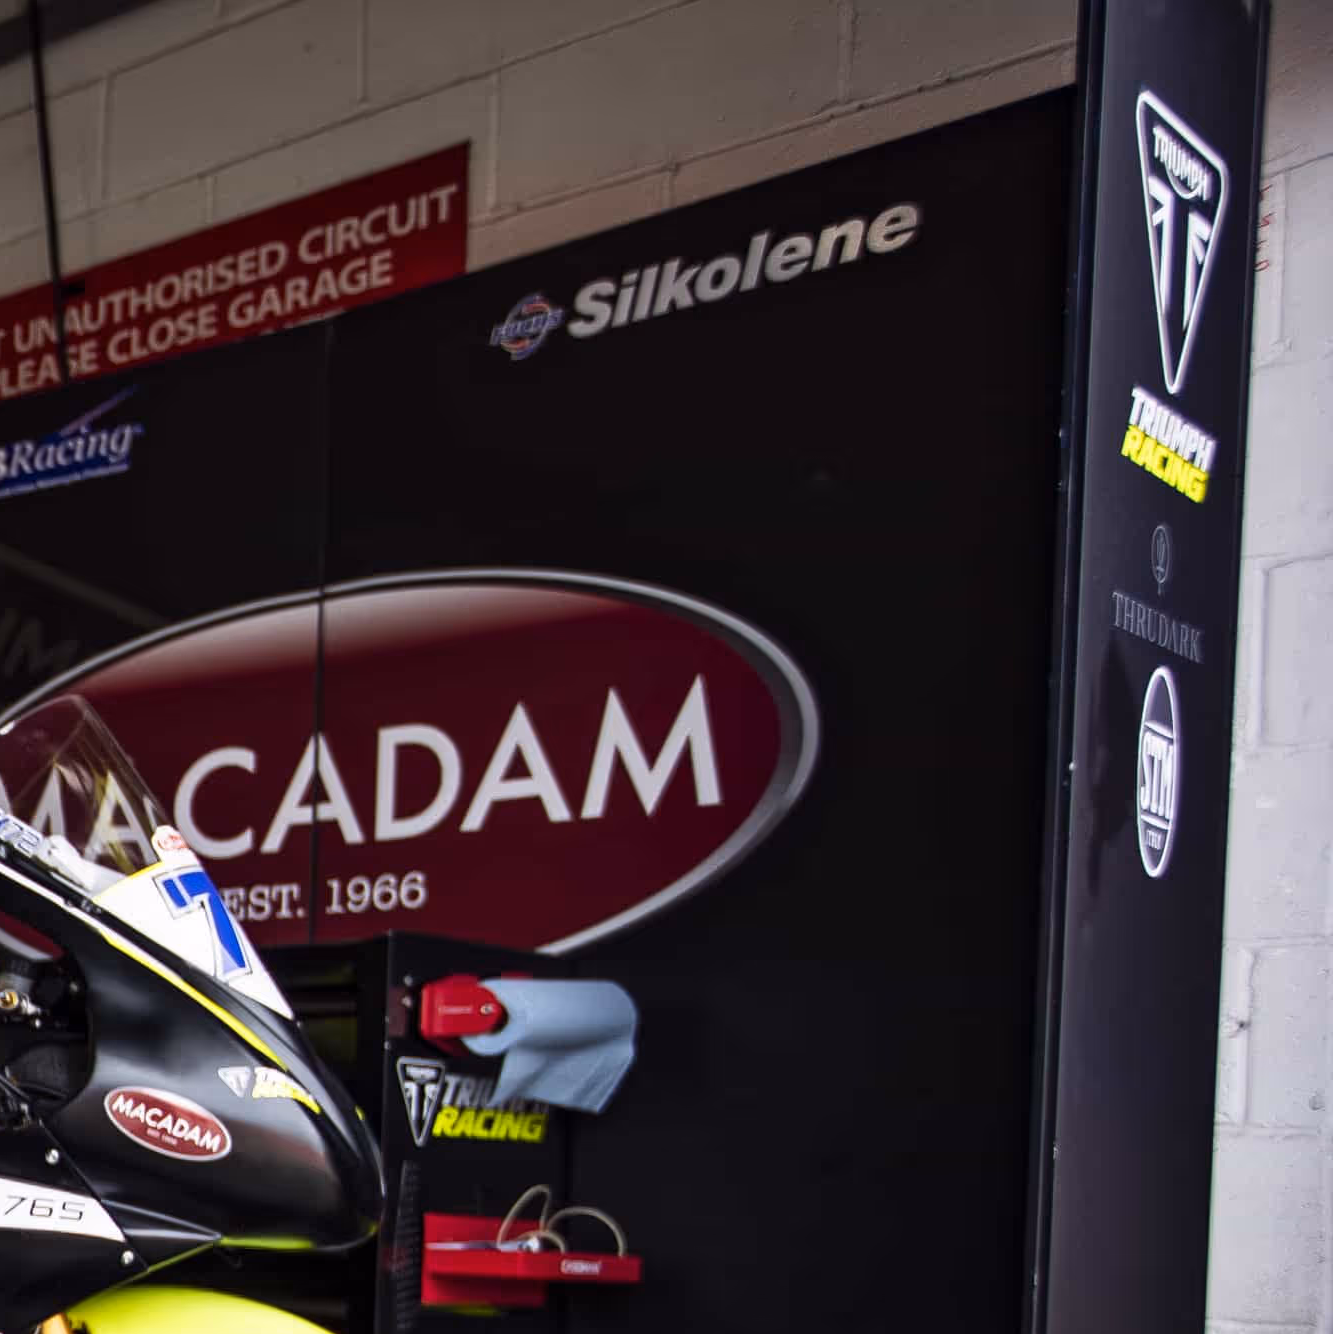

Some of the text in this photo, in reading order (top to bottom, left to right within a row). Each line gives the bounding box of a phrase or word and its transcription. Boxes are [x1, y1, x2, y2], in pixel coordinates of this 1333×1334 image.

[1152, 125, 1212, 200] TRIUMPH
[13, 241, 289, 352] UNAUTHORISED
[297, 183, 462, 267] CIRCUIT
[566, 203, 922, 338] Silkolene
[106, 303, 218, 366] CLOSE
[226, 249, 396, 329] GARAGE
[1119, 425, 1211, 504] RACING
[1130, 386, 1218, 472] TRIUMPH
[1111, 590, 1206, 664] THRUDARK
[324, 872, 429, 915] 1966
[111, 1094, 222, 1153] MACADAM
[431, 1107, 551, 1143] RACING
[4, 1194, 86, 1221] 765
